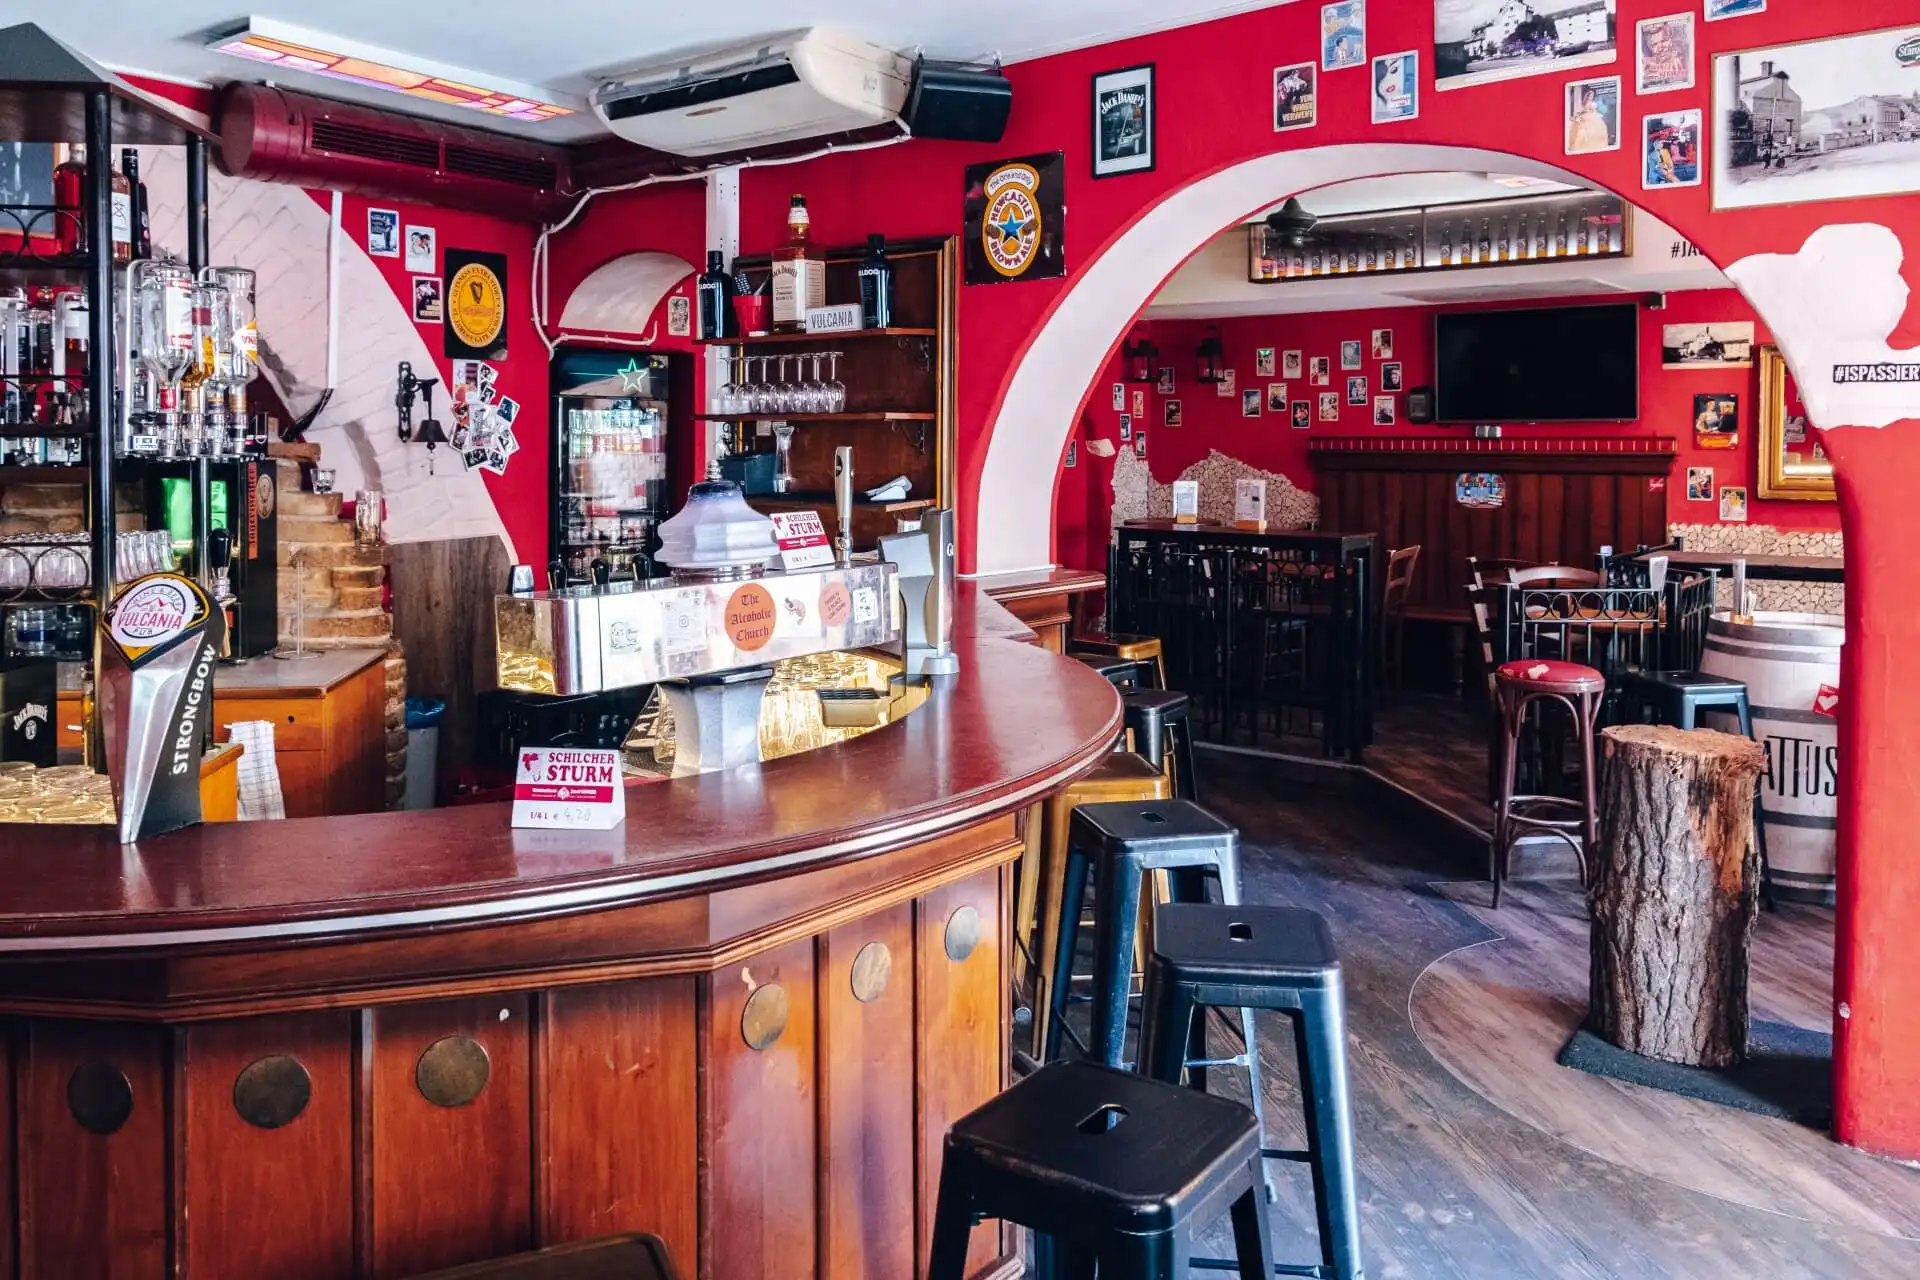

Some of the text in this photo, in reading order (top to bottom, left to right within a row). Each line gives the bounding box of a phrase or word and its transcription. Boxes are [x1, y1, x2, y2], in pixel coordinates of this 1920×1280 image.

[1101, 96, 1119, 115] JACK
[990, 191, 1033, 222] NEWCASTLE
[990, 236, 1033, 266] BROWN ALE
[811, 310, 854, 329] VULCANIA
[1833, 365, 1920, 383] #ISPASSIER
[786, 512, 818, 523] SCHILCHER
[789, 521, 823, 536] STURM
[740, 594, 760, 606] The
[117, 611, 184, 630] VULCANIA
[730, 607, 772, 625] Alcoholic
[735, 626, 769, 643] Church
[172, 643, 216, 776] STRONGBOW
[548, 752, 615, 765] SCHILCHER
[547, 765, 614, 783] STURM
